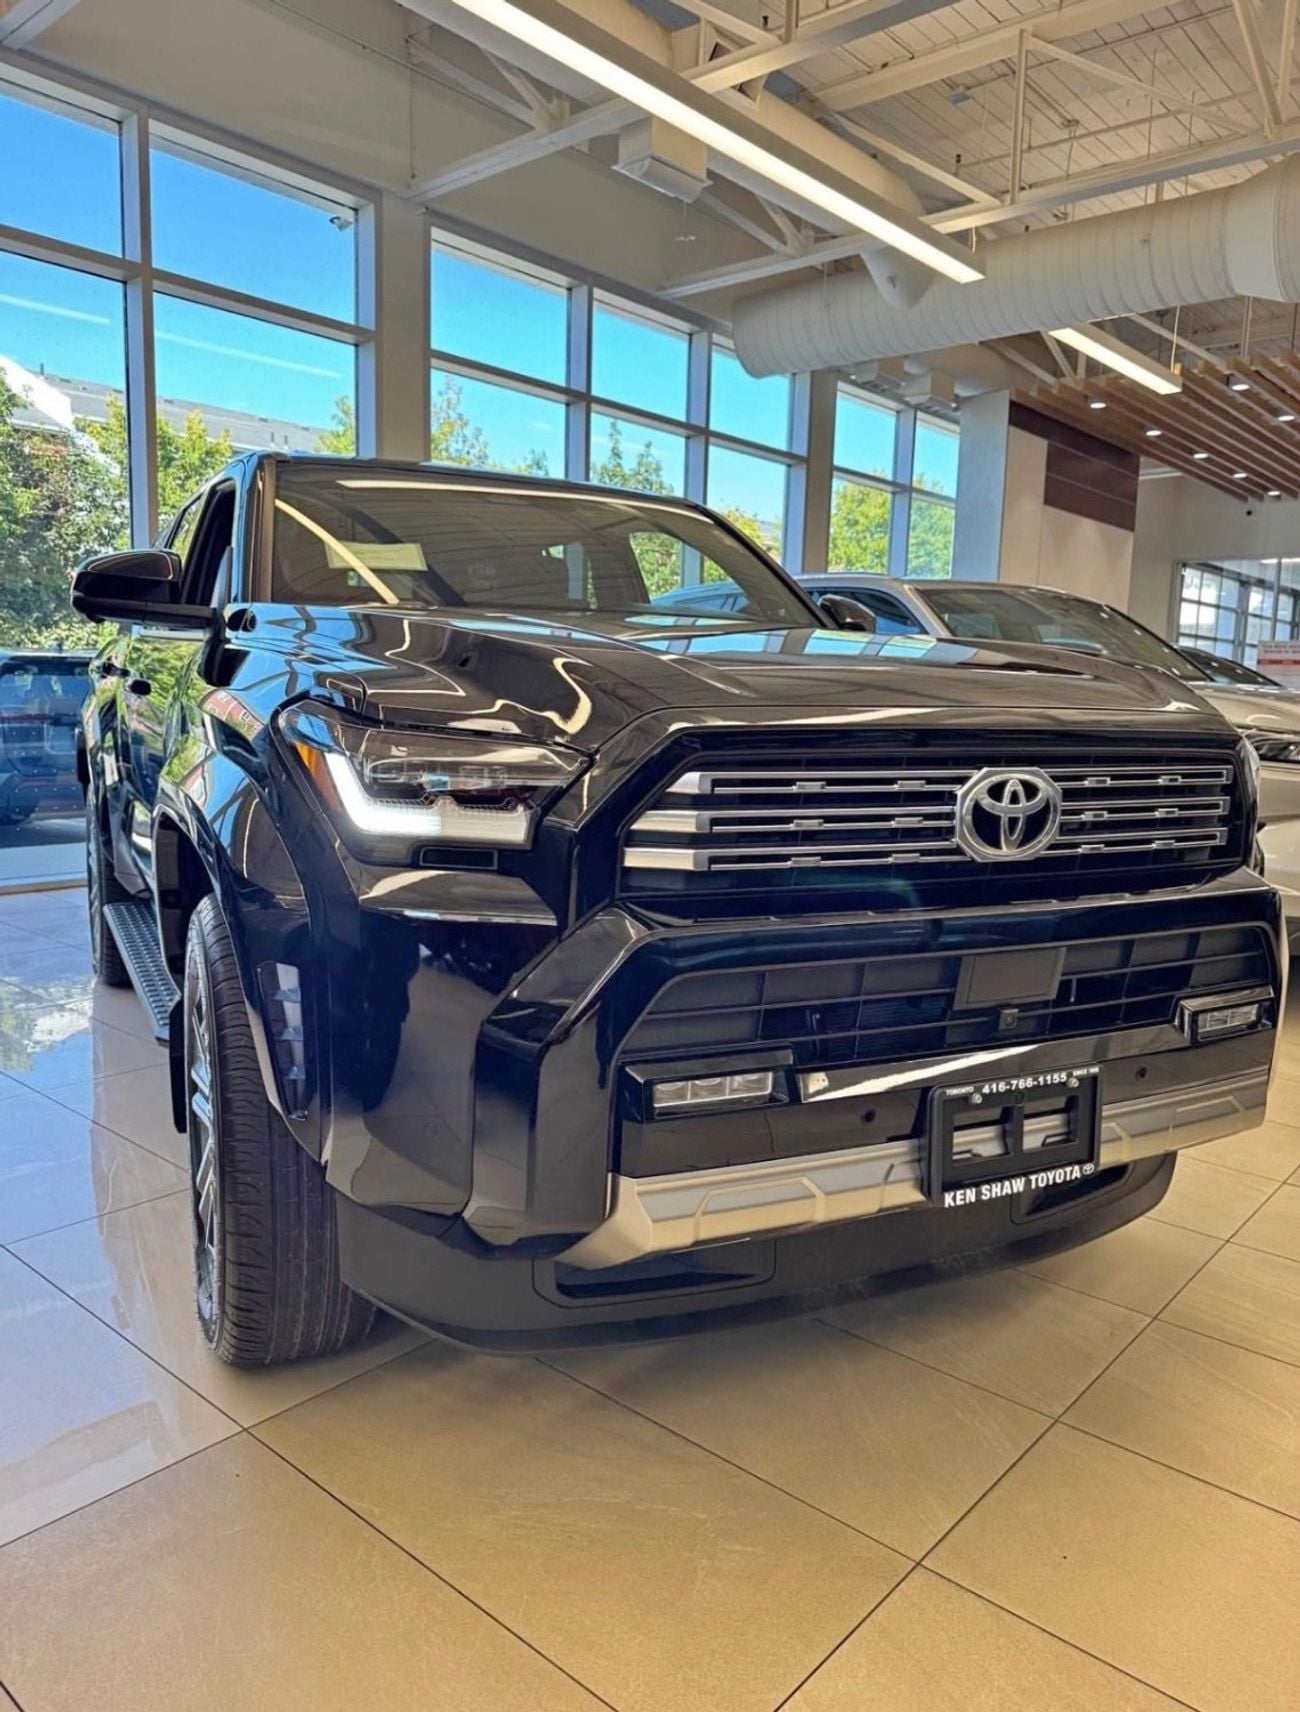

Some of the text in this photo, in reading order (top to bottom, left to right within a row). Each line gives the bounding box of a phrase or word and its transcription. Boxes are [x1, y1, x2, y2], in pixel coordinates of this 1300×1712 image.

[946, 1086, 974, 1096] TORONTO
[982, 1072, 1068, 1095] 416-766-1155
[944, 1165, 1081, 1208] KEN SHAW TOYOTA
